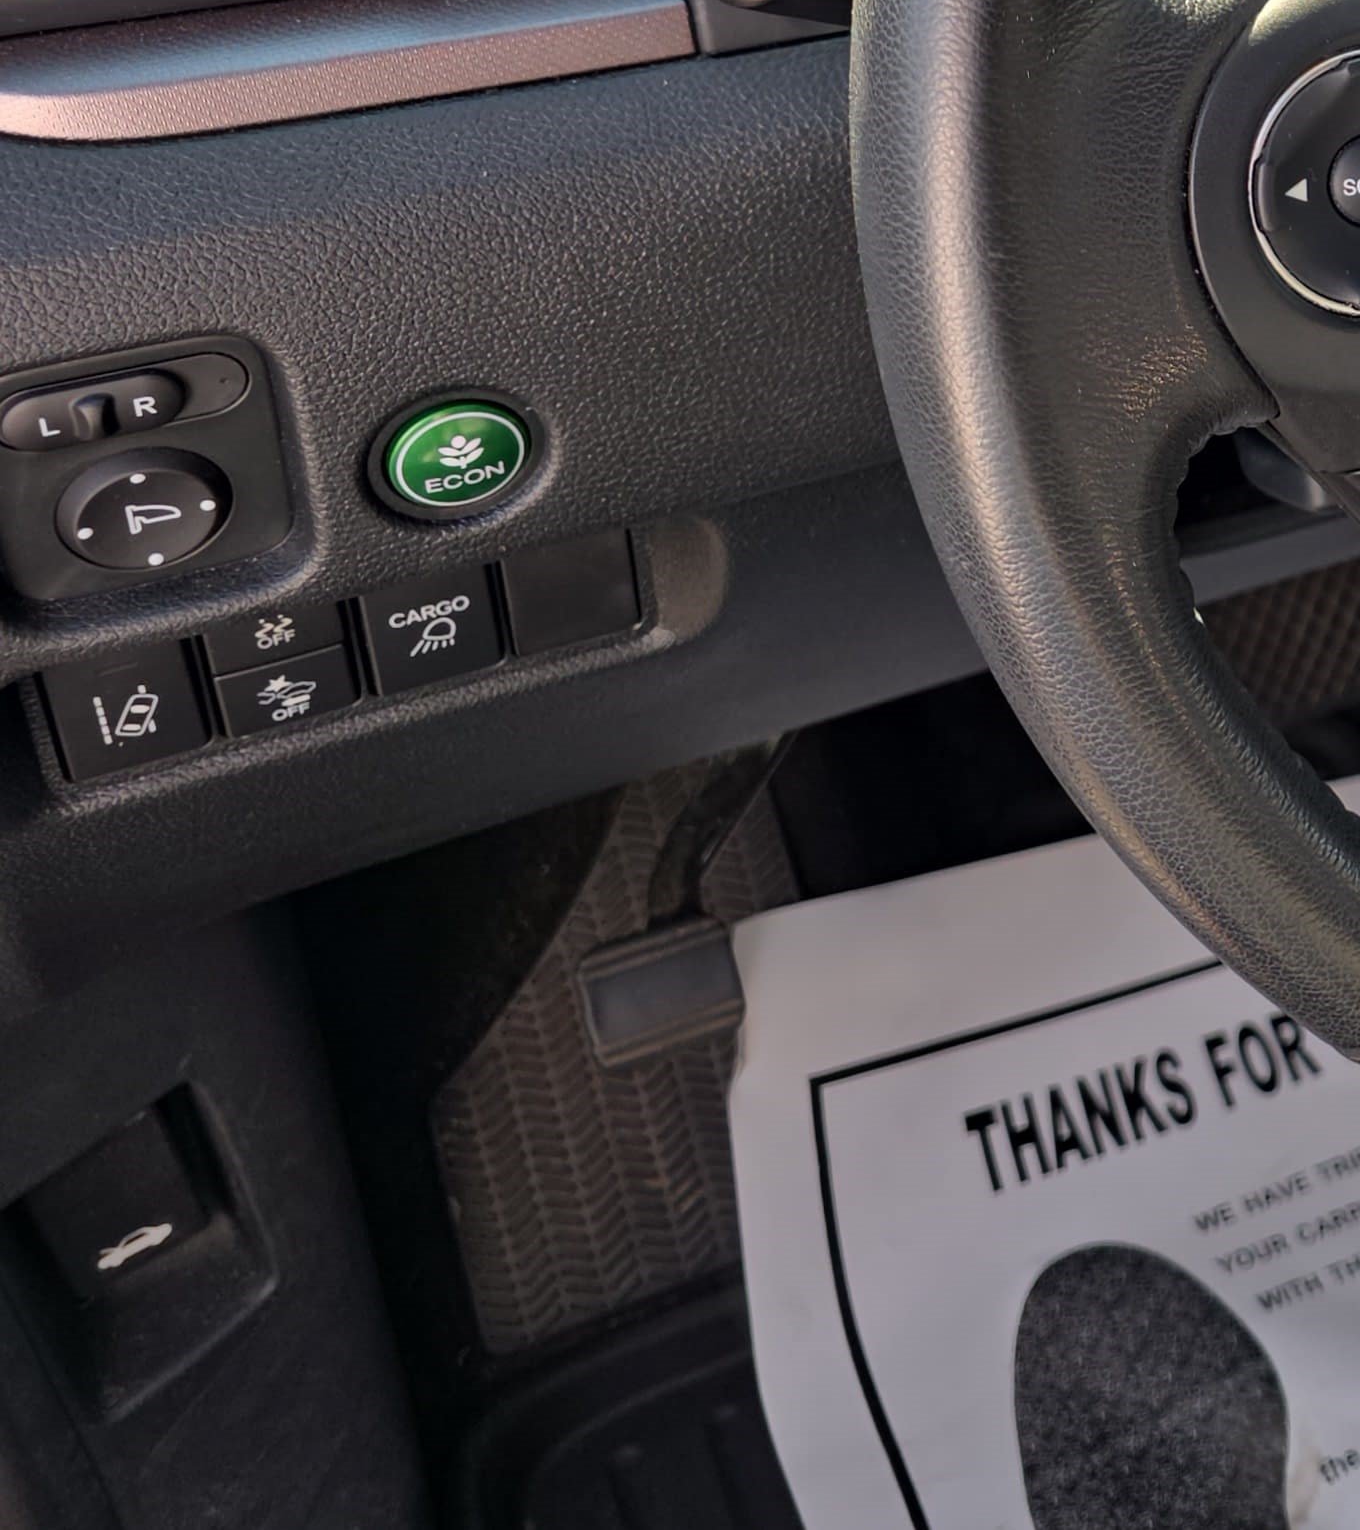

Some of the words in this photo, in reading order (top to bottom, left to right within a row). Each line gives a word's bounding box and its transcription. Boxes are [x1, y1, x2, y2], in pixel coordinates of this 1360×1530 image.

[38, 416, 61, 438] L
[133, 396, 158, 418] R
[424, 461, 506, 494] ECON
[388, 595, 470, 629] CARGO
[257, 629, 296, 650] OFF
[272, 702, 311, 721] OFF
[964, 1048, 1198, 1194] THANKS
[1205, 1012, 1322, 1108] FOR
[1195, 1201, 1236, 1233] WE
[1244, 1172, 1311, 1213] HAVE
[1215, 1233, 1289, 1274] YOUR
[1256, 1272, 1324, 1312] WITH
[1319, 1449, 1360, 1485] the
